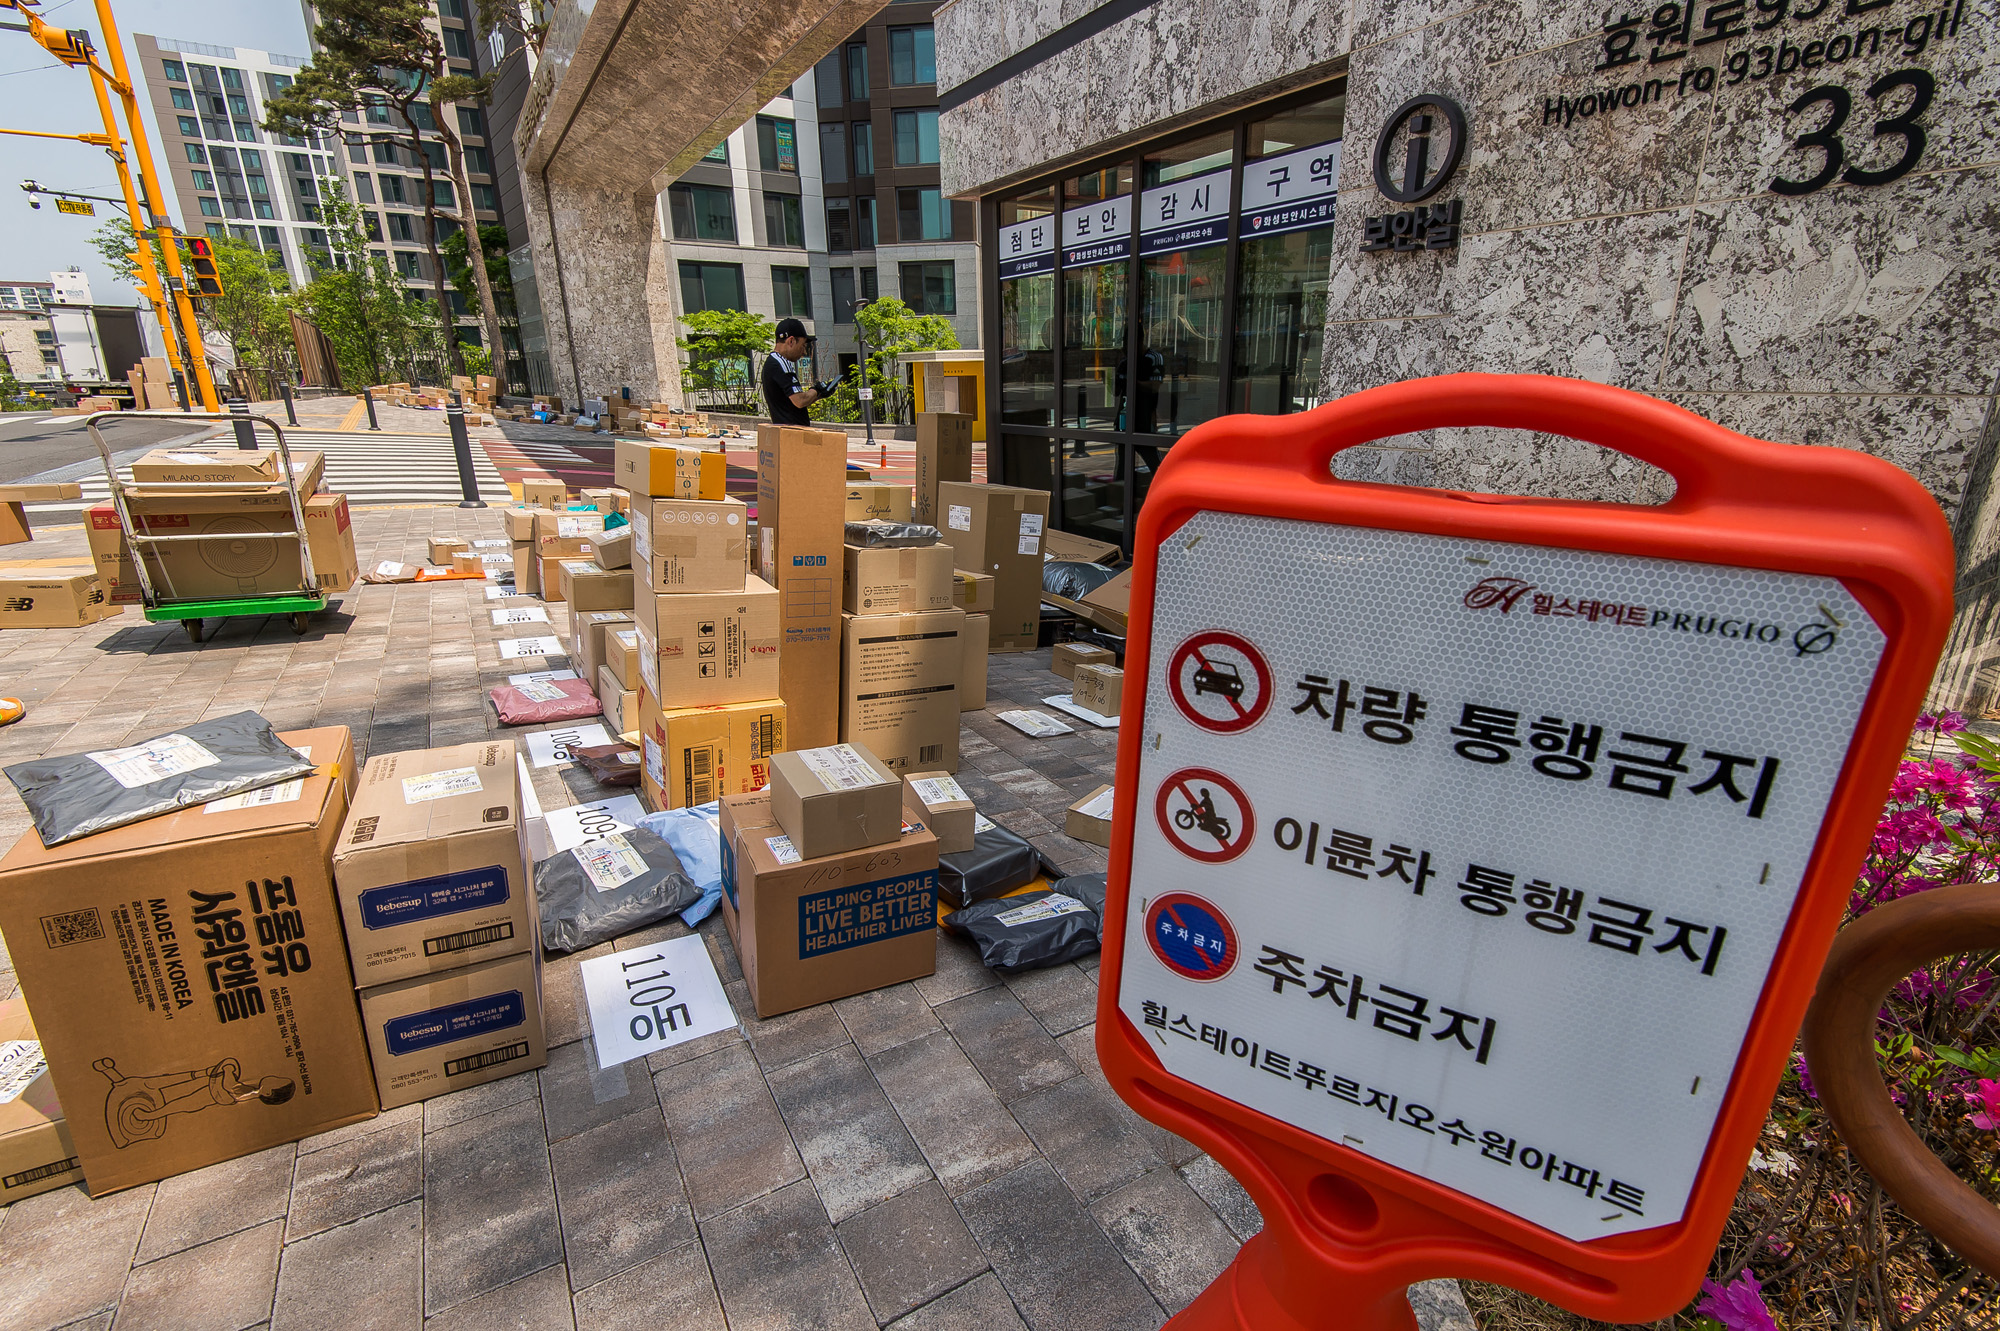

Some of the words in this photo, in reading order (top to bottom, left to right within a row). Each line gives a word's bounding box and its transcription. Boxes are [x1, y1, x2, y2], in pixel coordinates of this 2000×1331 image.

[1542, 67, 1715, 128] Hyowon-ro
[1726, 0, 1963, 88] 93beon-gil
[1769, 68, 1936, 196] 33
[1011, 226, 1043, 253] 첨단
[1076, 208, 1116, 237] 보안
[1160, 184, 1211, 221] 감시
[1266, 154, 1334, 197] 구역
[1264, 205, 1327, 227] 화성보안시스템
[1181, 230, 1201, 241] 푸르지오
[1201, 227, 1213, 237] 수원
[1360, 201, 1463, 254] 보안실
[163, 474, 200, 482] MILANO
[1532, 593, 1649, 628] 힐스테이트
[1650, 610, 1781, 644] PRUGIO
[1291, 672, 1427, 745] 차량
[1450, 698, 1781, 820] 통행금지
[803, 852, 902, 889] 110-603
[376, 898, 422, 913] Bebesup
[805, 889, 872, 915] HELPING
[877, 876, 933, 899] PEOPLE
[806, 908, 852, 935] LIVE
[860, 892, 931, 923] BETTER
[1273, 815, 1436, 897] 이륜차
[1457, 860, 1729, 977] 통행금지
[148, 899, 176, 942] MADE
[246, 876, 311, 977] 프롬유
[475, 919, 489, 927] Made
[496, 915, 512, 923] Korea
[806, 922, 886, 951] HEALTHIER
[892, 911, 932, 931] LIVES
[1161, 922, 1222, 953] 주차금지
[161, 943, 180, 959] IN
[188, 891, 265, 1024] 샤워핸들
[366, 946, 407, 960] 고객만족센터
[384, 952, 417, 963] 553-7015
[165, 960, 193, 1010] KOREA
[621, 953, 693, 1041] 110동
[1253, 944, 1498, 1065] 주차금지
[400, 1024, 443, 1040] Bebesup
[408, 1073, 438, 1085] 553-7015
[1142, 999, 1646, 1217] 힐스테이트푸르지오수원아파트
